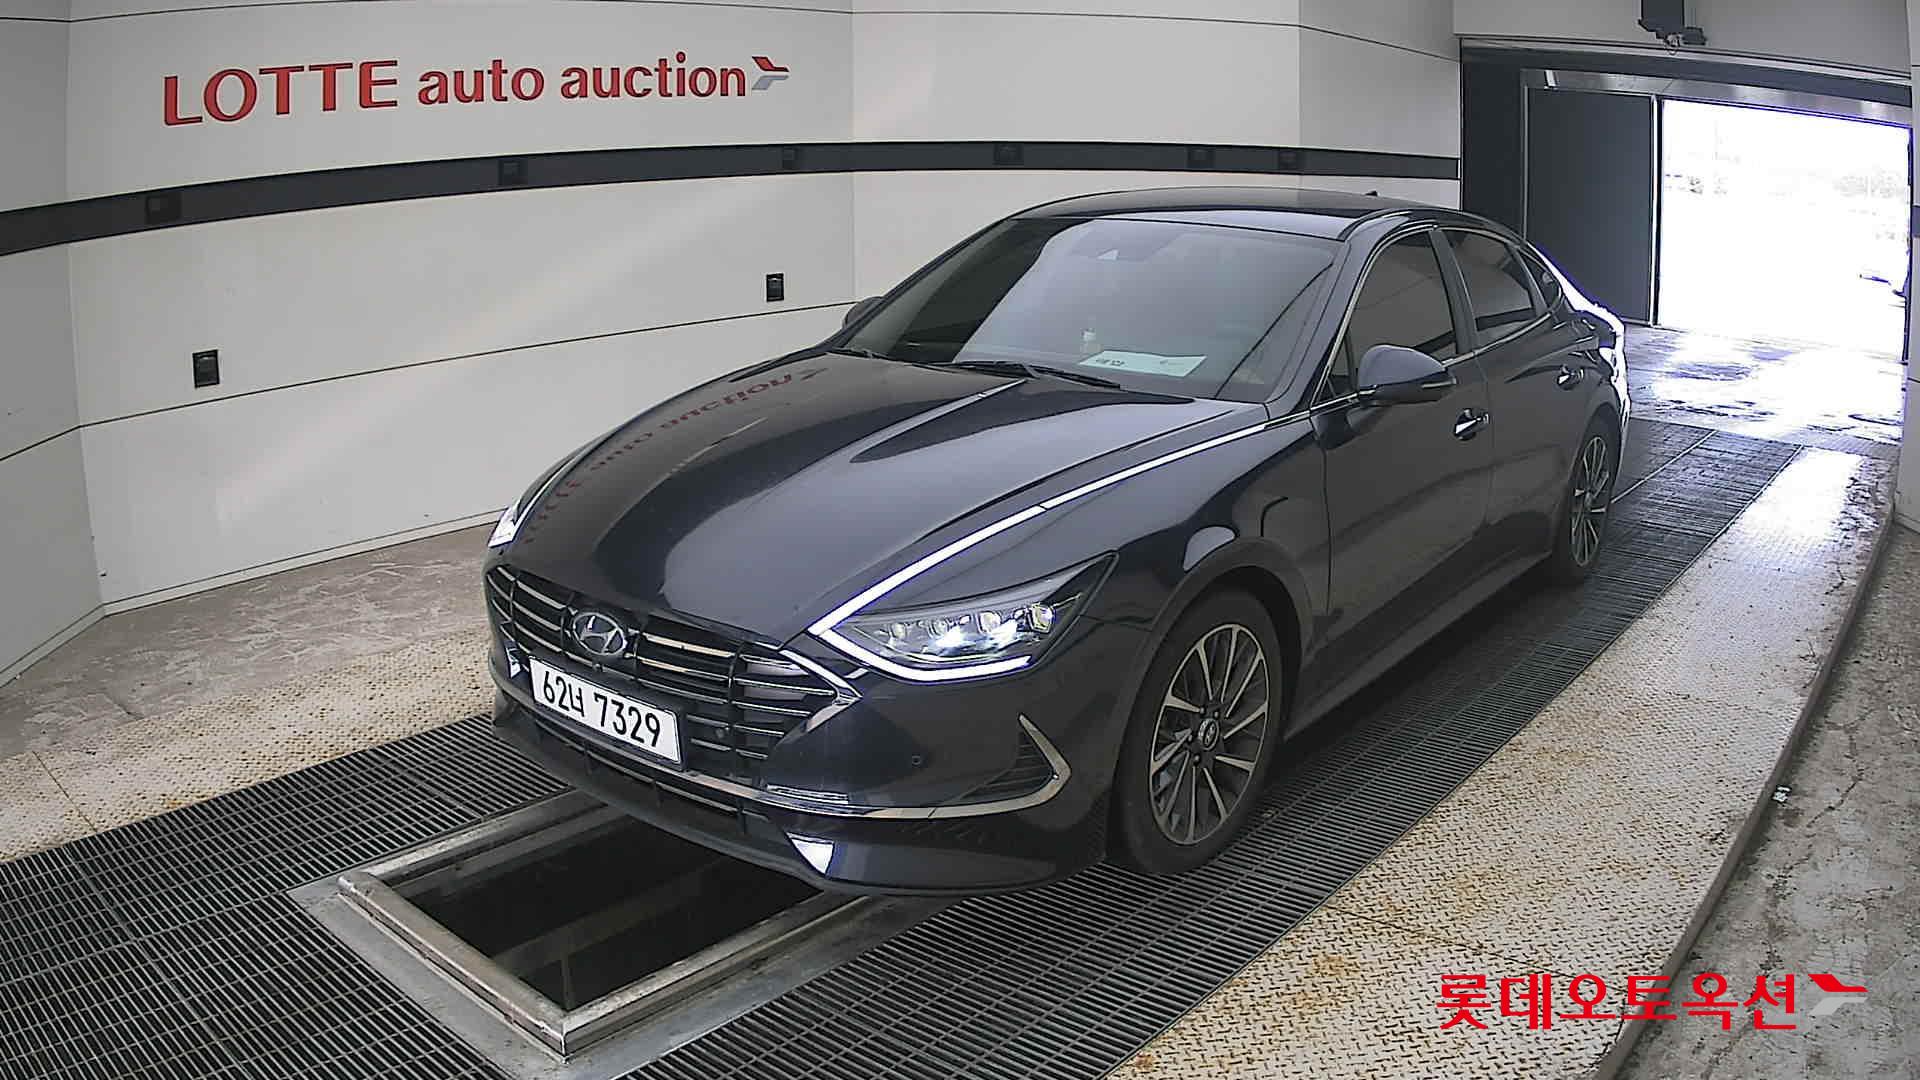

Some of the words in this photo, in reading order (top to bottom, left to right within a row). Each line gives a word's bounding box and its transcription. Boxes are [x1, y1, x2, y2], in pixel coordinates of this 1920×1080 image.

[163, 59, 399, 127] LOTTE
[418, 59, 546, 105] auto
[560, 51, 747, 99] auction
[543, 671, 585, 718] 62너
[594, 692, 661, 748] 7329
